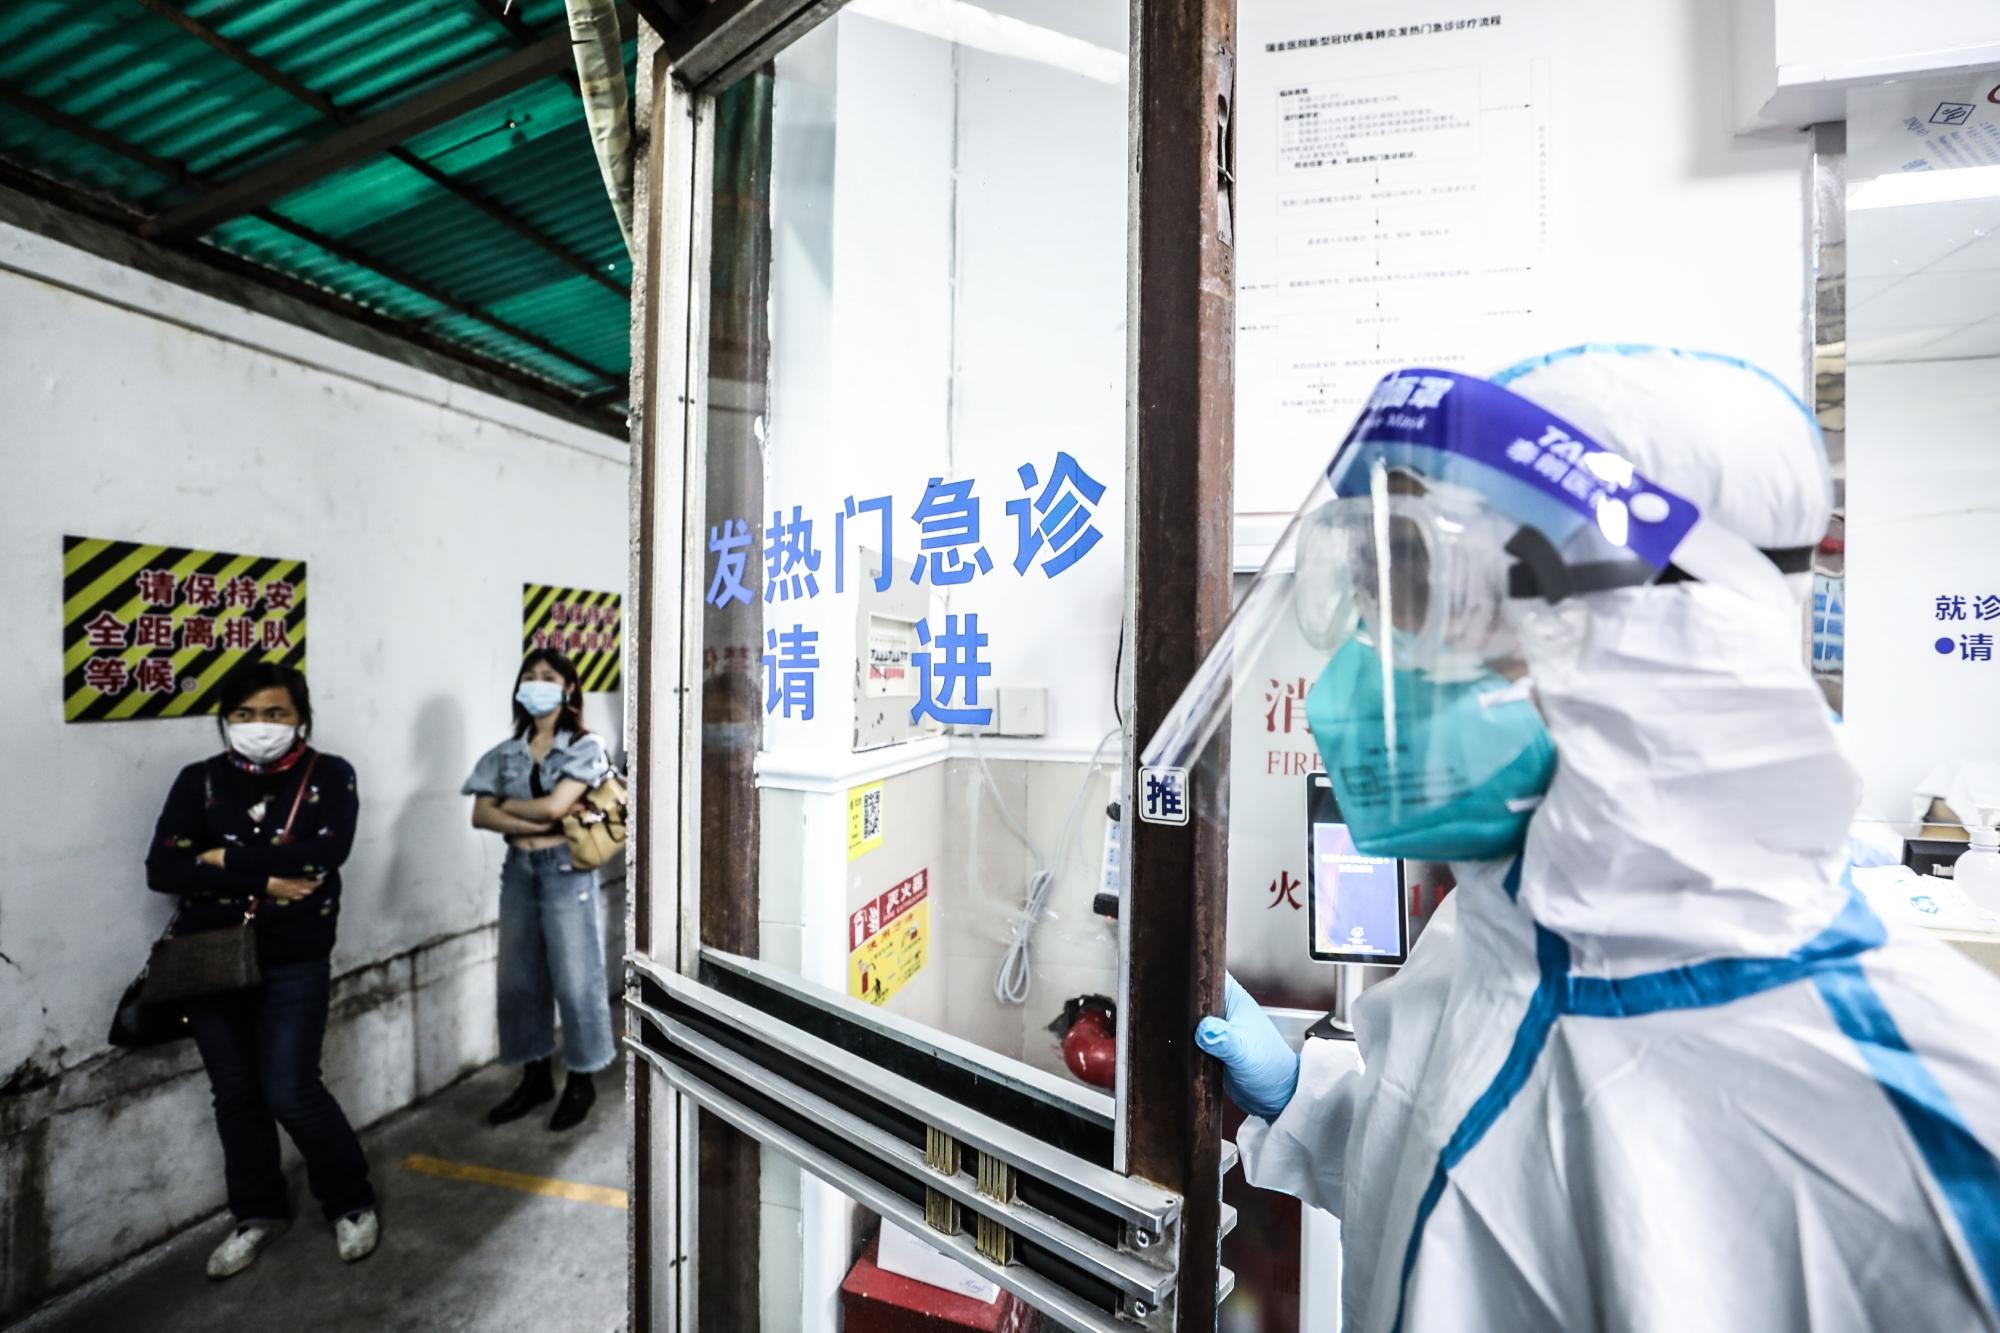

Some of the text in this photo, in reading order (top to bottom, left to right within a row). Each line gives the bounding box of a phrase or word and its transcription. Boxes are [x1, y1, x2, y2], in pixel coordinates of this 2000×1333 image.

[705, 451, 1107, 609] 发热门急诊
[137, 569, 294, 611] 请保持安
[1935, 594, 2000, 621] 就诊
[84, 610, 291, 649] 全距离排队
[1959, 632, 1994, 661] 请
[1146, 774, 1183, 816] 推
